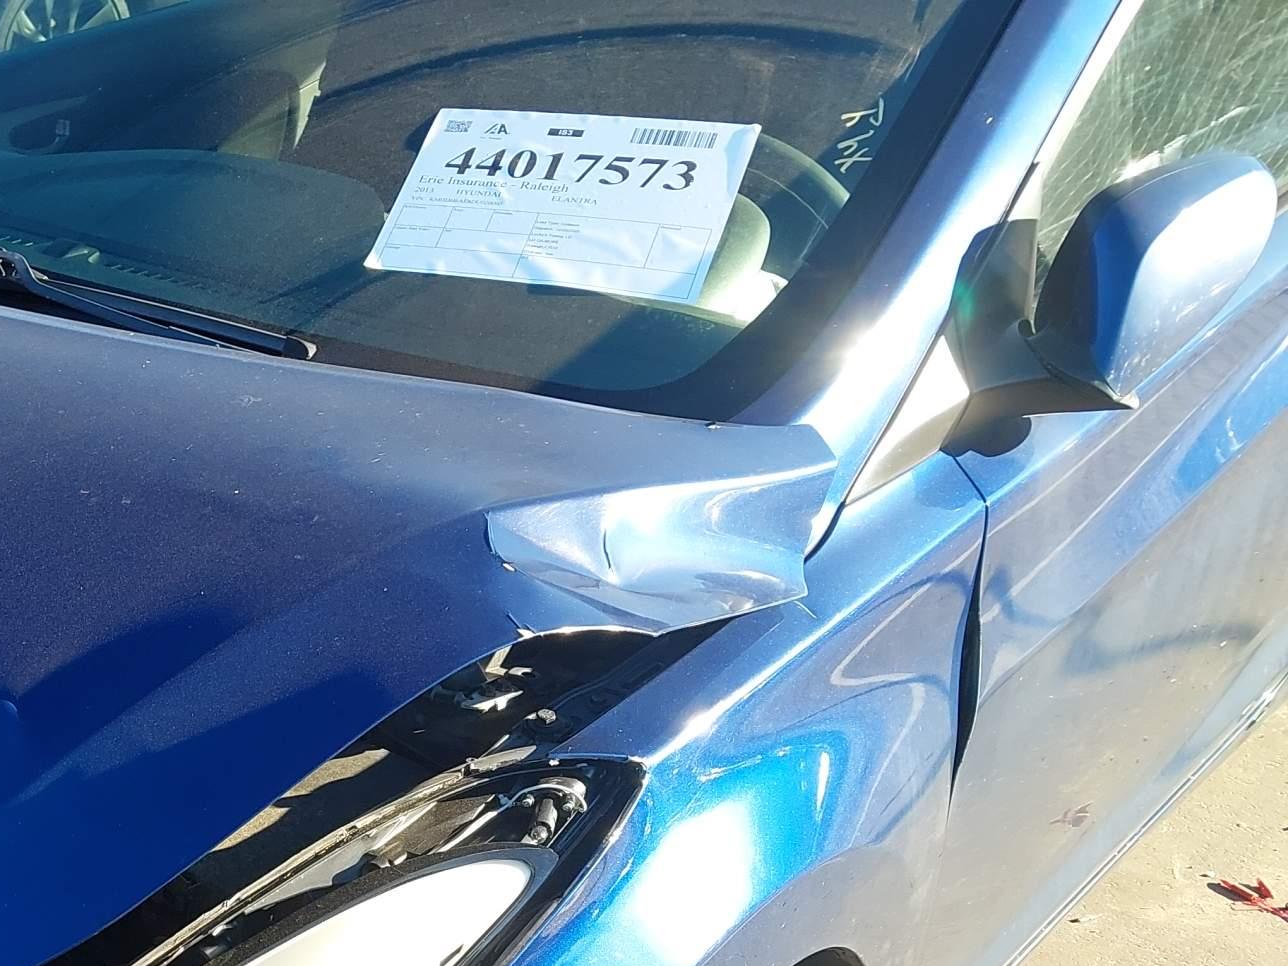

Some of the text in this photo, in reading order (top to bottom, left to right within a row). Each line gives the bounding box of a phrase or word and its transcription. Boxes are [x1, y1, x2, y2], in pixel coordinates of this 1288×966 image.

[444, 147, 698, 191] 44017573
[419, 175, 445, 185] Erie
[448, 176, 508, 189] Insurance
[520, 182, 569, 194] Raleigh
[456, 189, 502, 198] HYUNDAI
